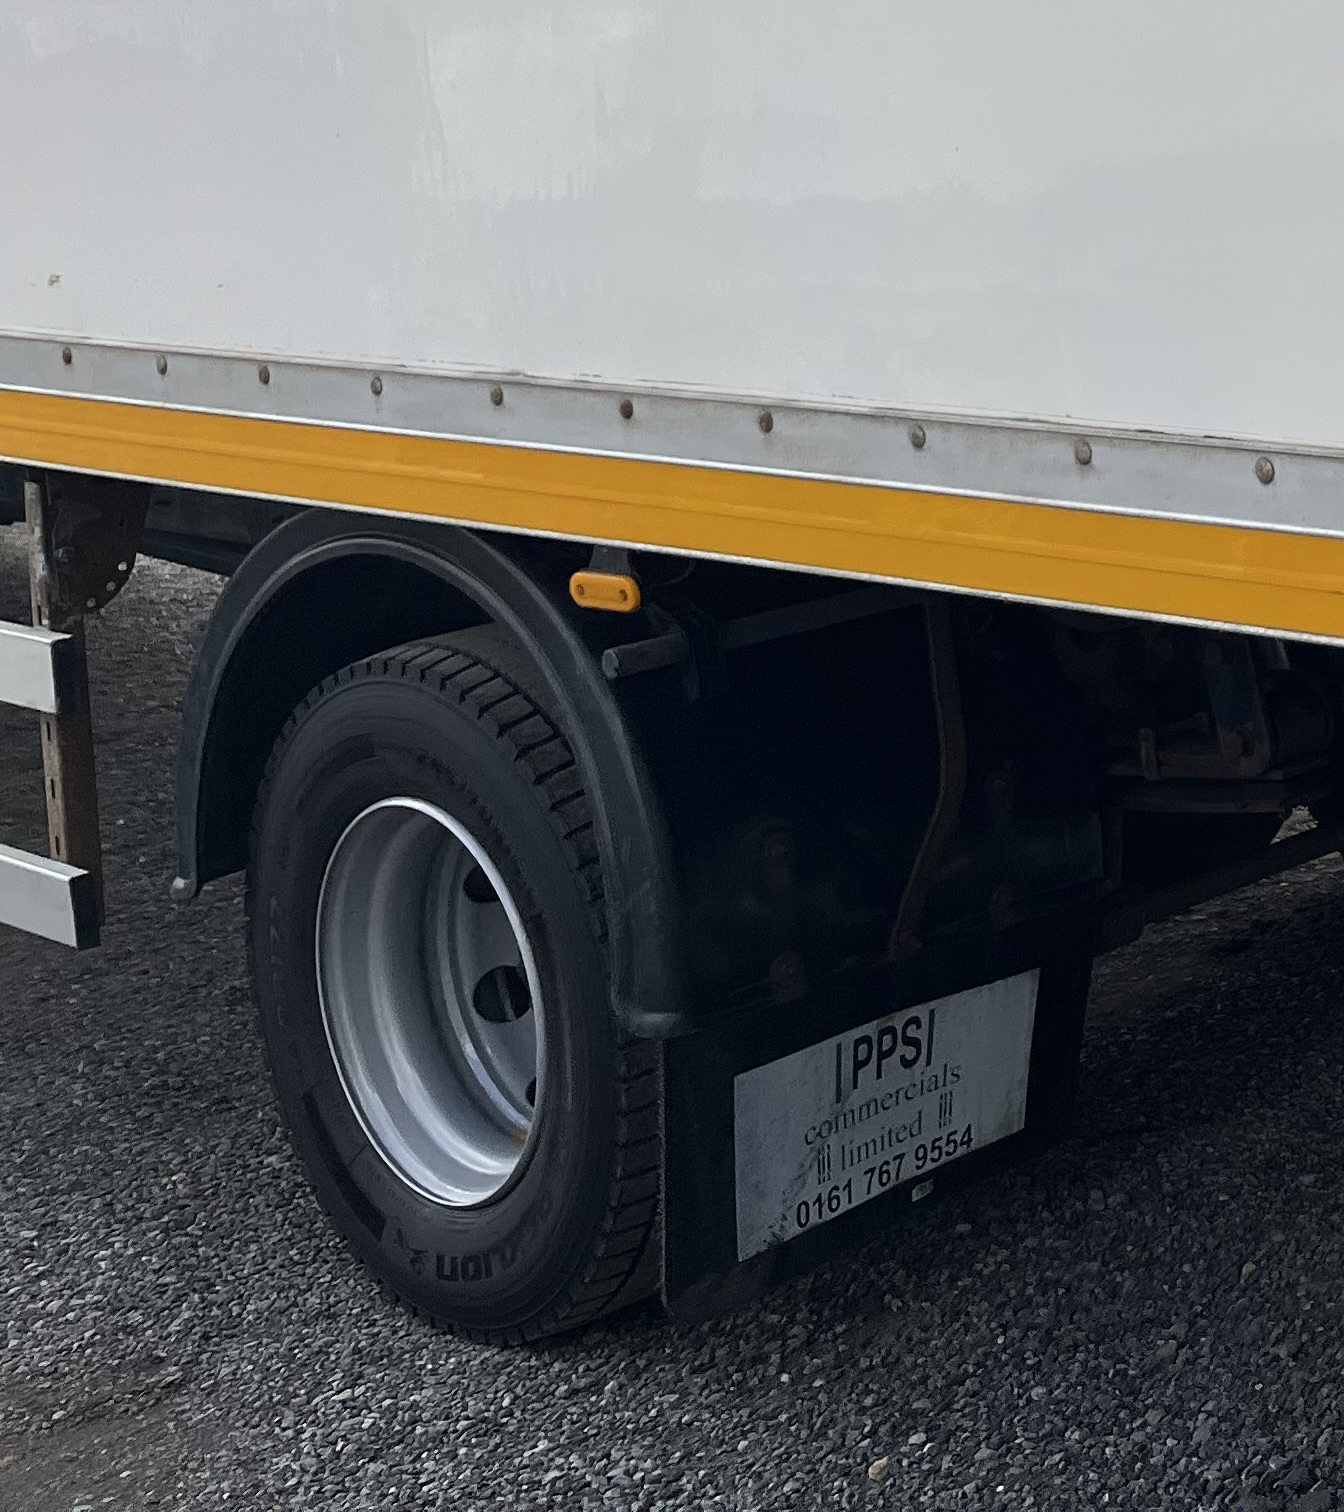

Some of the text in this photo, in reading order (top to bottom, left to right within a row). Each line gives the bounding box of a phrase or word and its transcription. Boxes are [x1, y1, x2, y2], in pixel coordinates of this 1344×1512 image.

[804, 1061, 964, 1146] commercials
[841, 1110, 923, 1171] limited
[796, 1123, 974, 1229] 0161 767 9554
